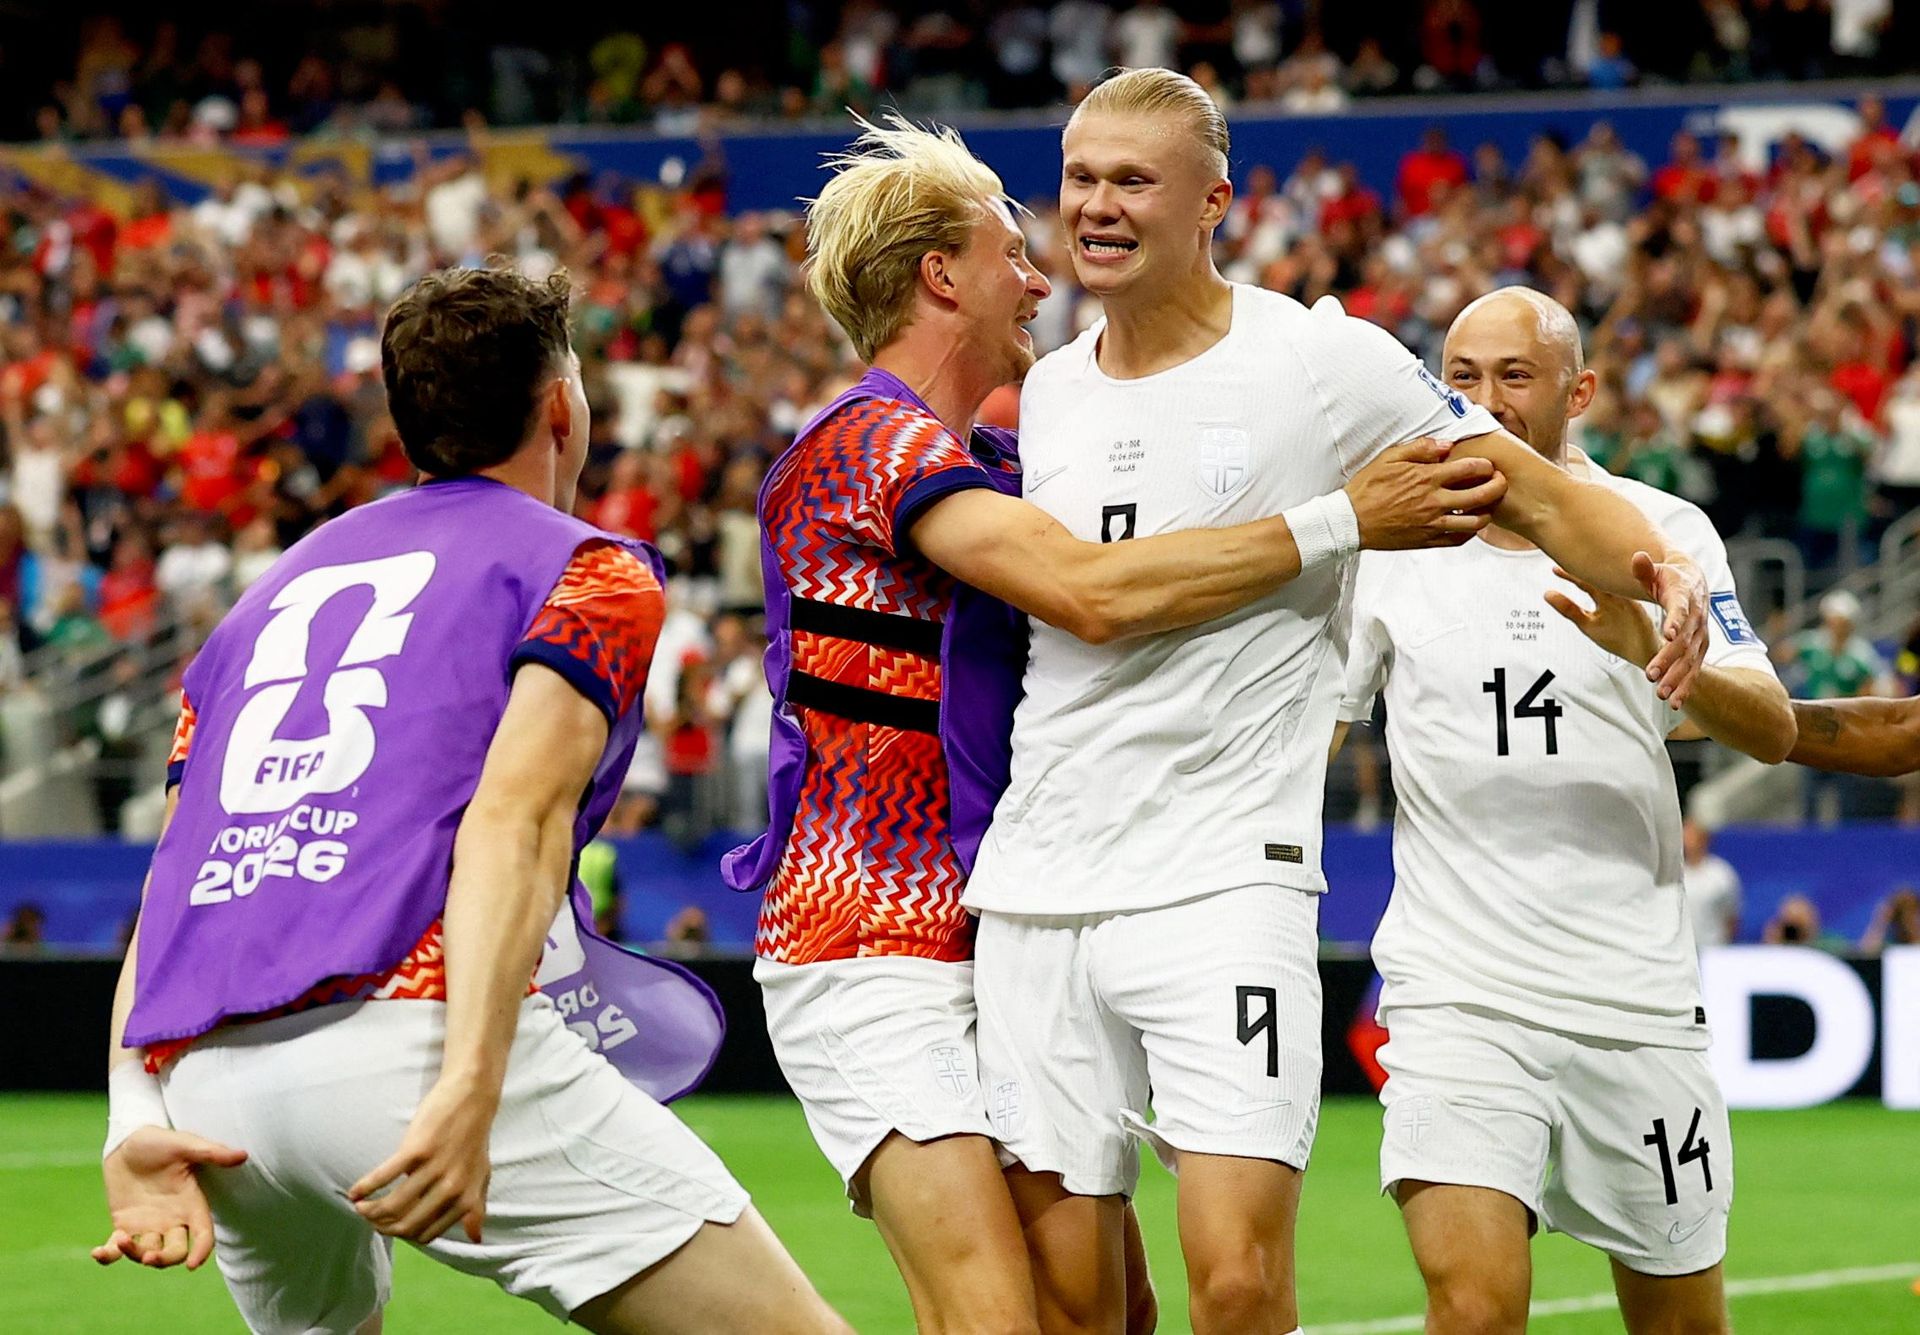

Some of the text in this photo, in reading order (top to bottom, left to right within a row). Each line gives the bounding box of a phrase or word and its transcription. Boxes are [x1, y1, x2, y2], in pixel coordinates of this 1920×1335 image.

[1482, 667, 1562, 756] 14
[254, 750, 325, 785] FIFA
[288, 804, 359, 836] CUP
[189, 835, 349, 906] 2026
[1236, 985, 1279, 1078] 9
[1643, 1106, 1713, 1206] 14
